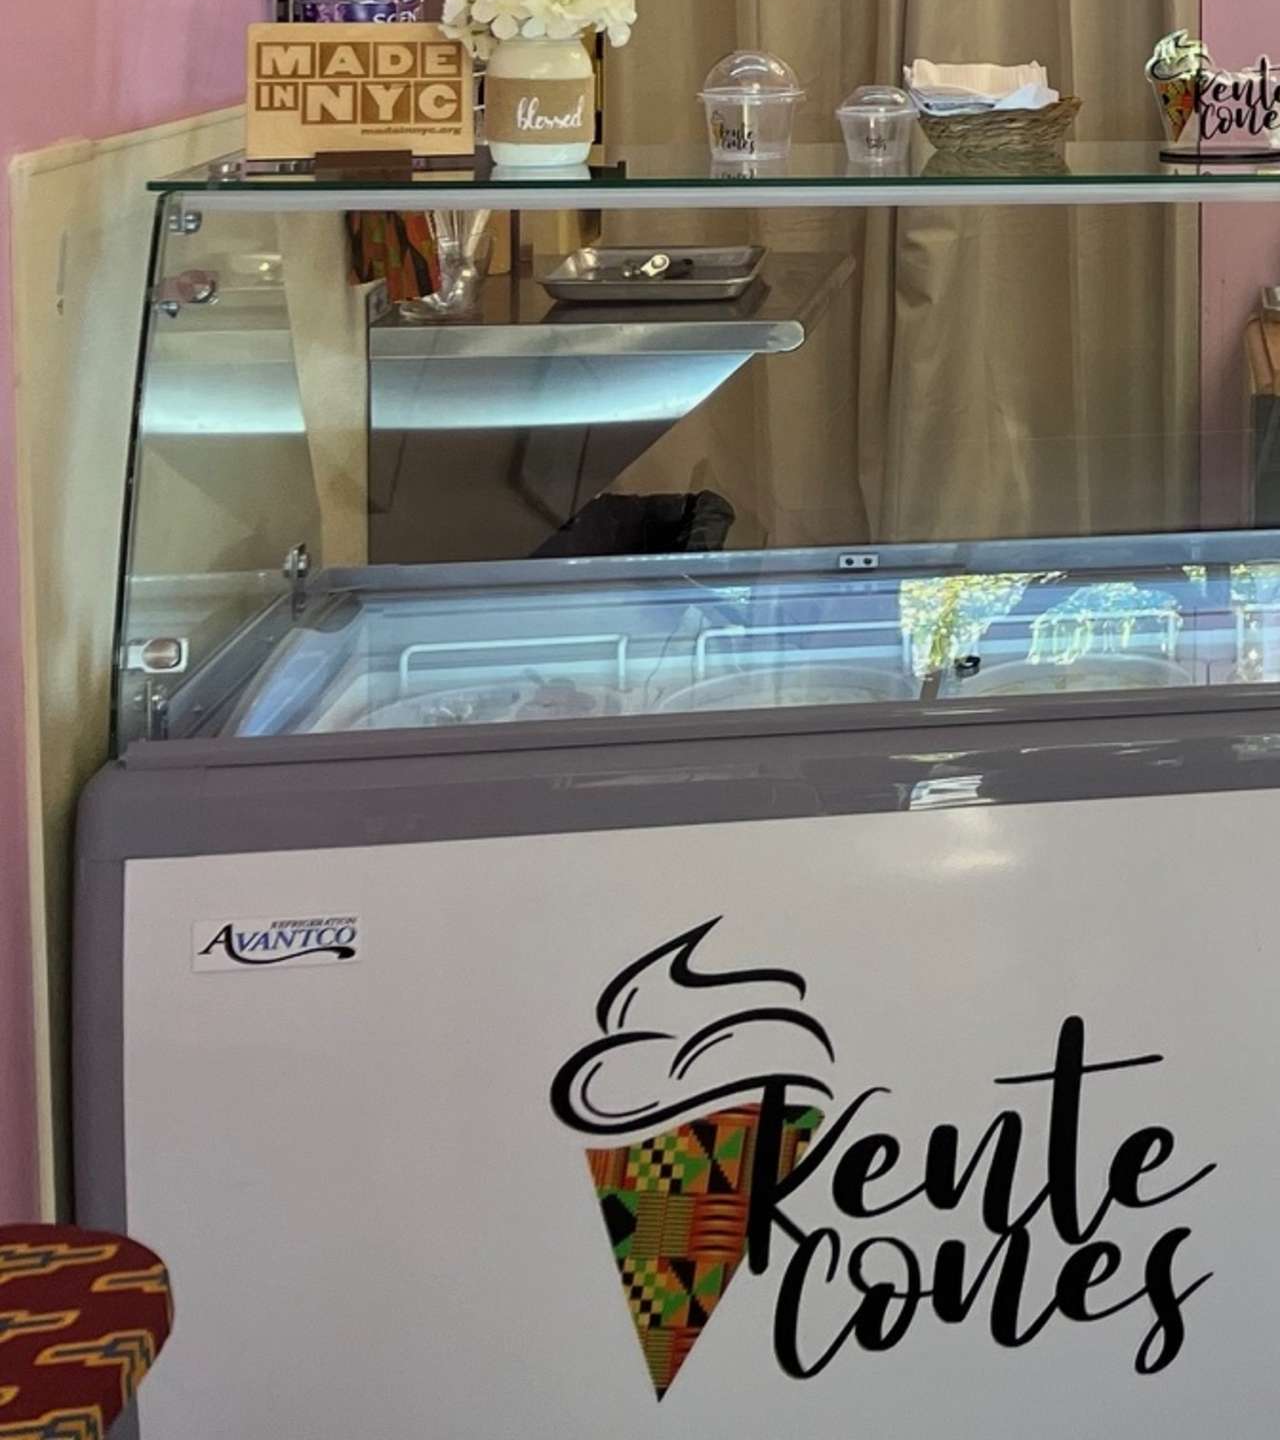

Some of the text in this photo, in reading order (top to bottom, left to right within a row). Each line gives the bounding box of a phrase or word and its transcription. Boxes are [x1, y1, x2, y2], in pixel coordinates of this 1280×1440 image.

[260, 44, 458, 75] MADE
[260, 83, 458, 121] IN NYC
[517, 96, 584, 130] blessed
[198, 923, 357, 964] AVANTCO
